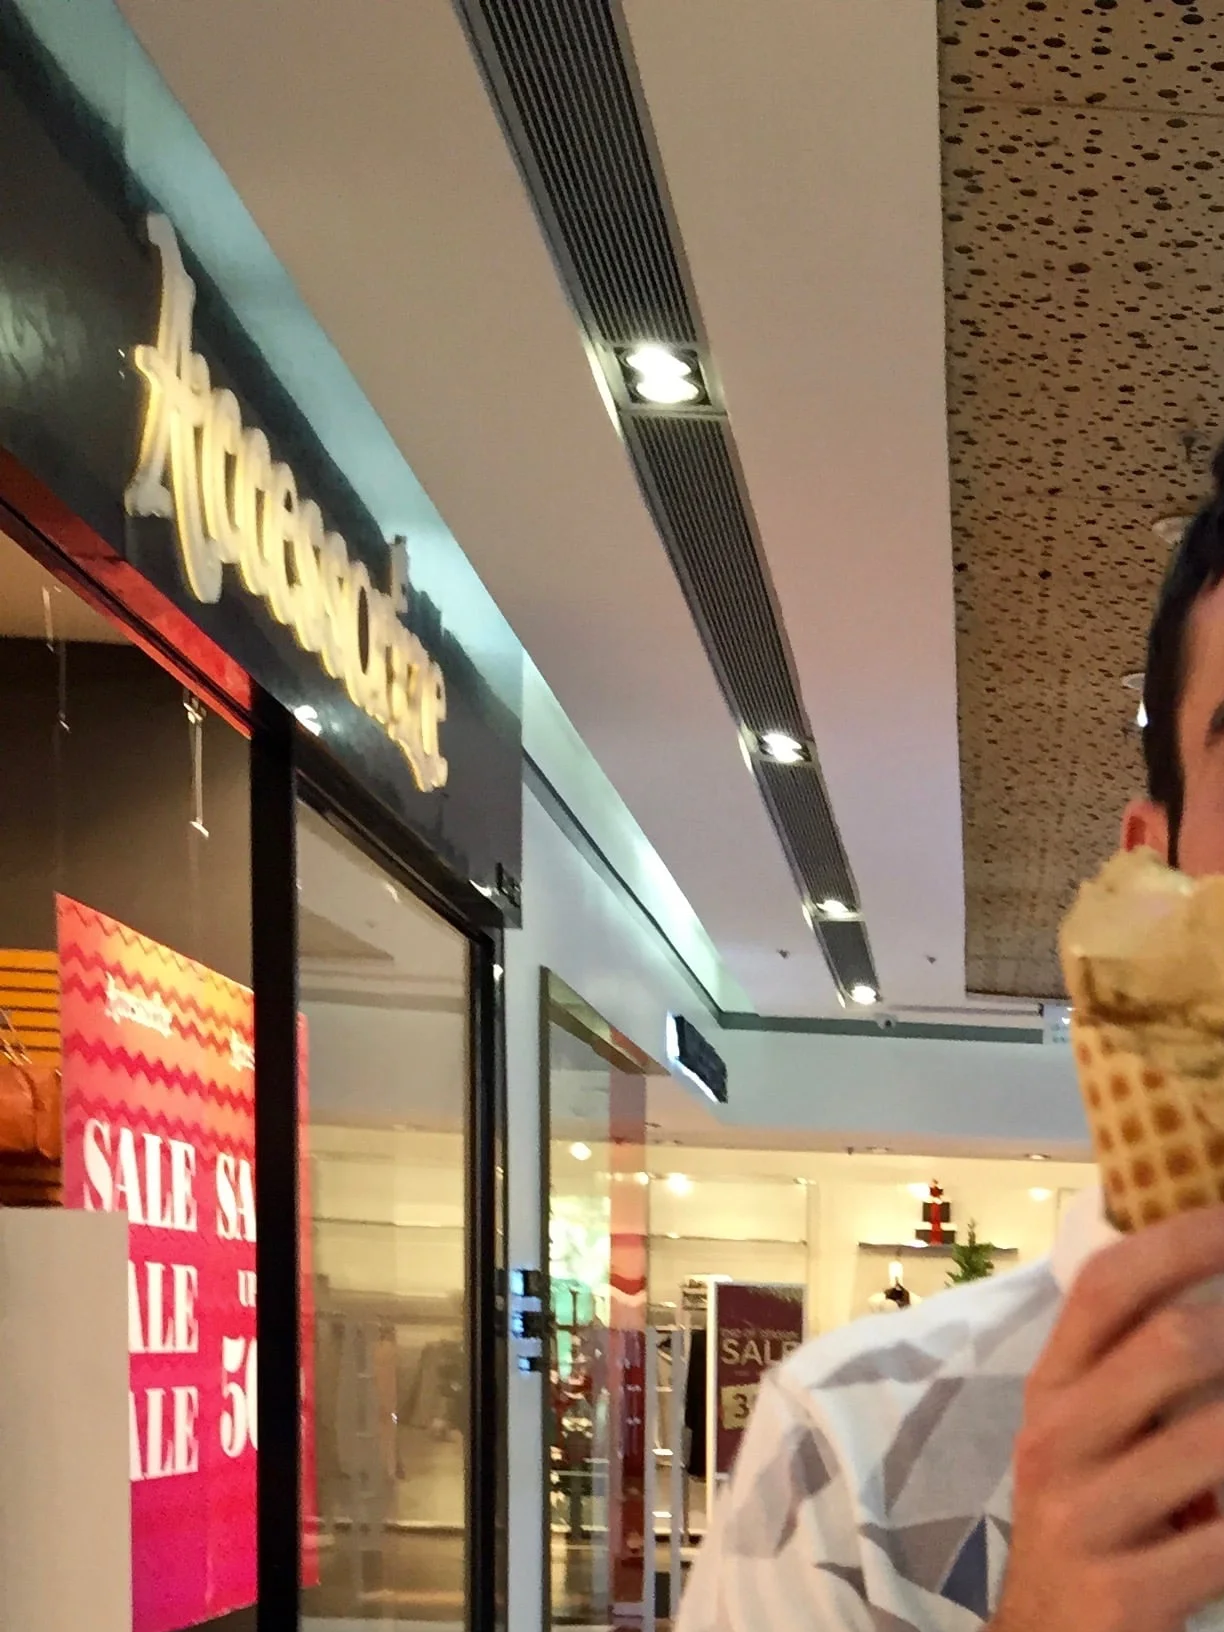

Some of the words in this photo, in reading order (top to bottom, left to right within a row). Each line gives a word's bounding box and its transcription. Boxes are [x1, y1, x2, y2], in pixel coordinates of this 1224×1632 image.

[83, 1117, 198, 1232] SALE
[215, 1151, 257, 1242] SA
[128, 1259, 199, 1354] ALE
[128, 1386, 199, 1482] ALE
